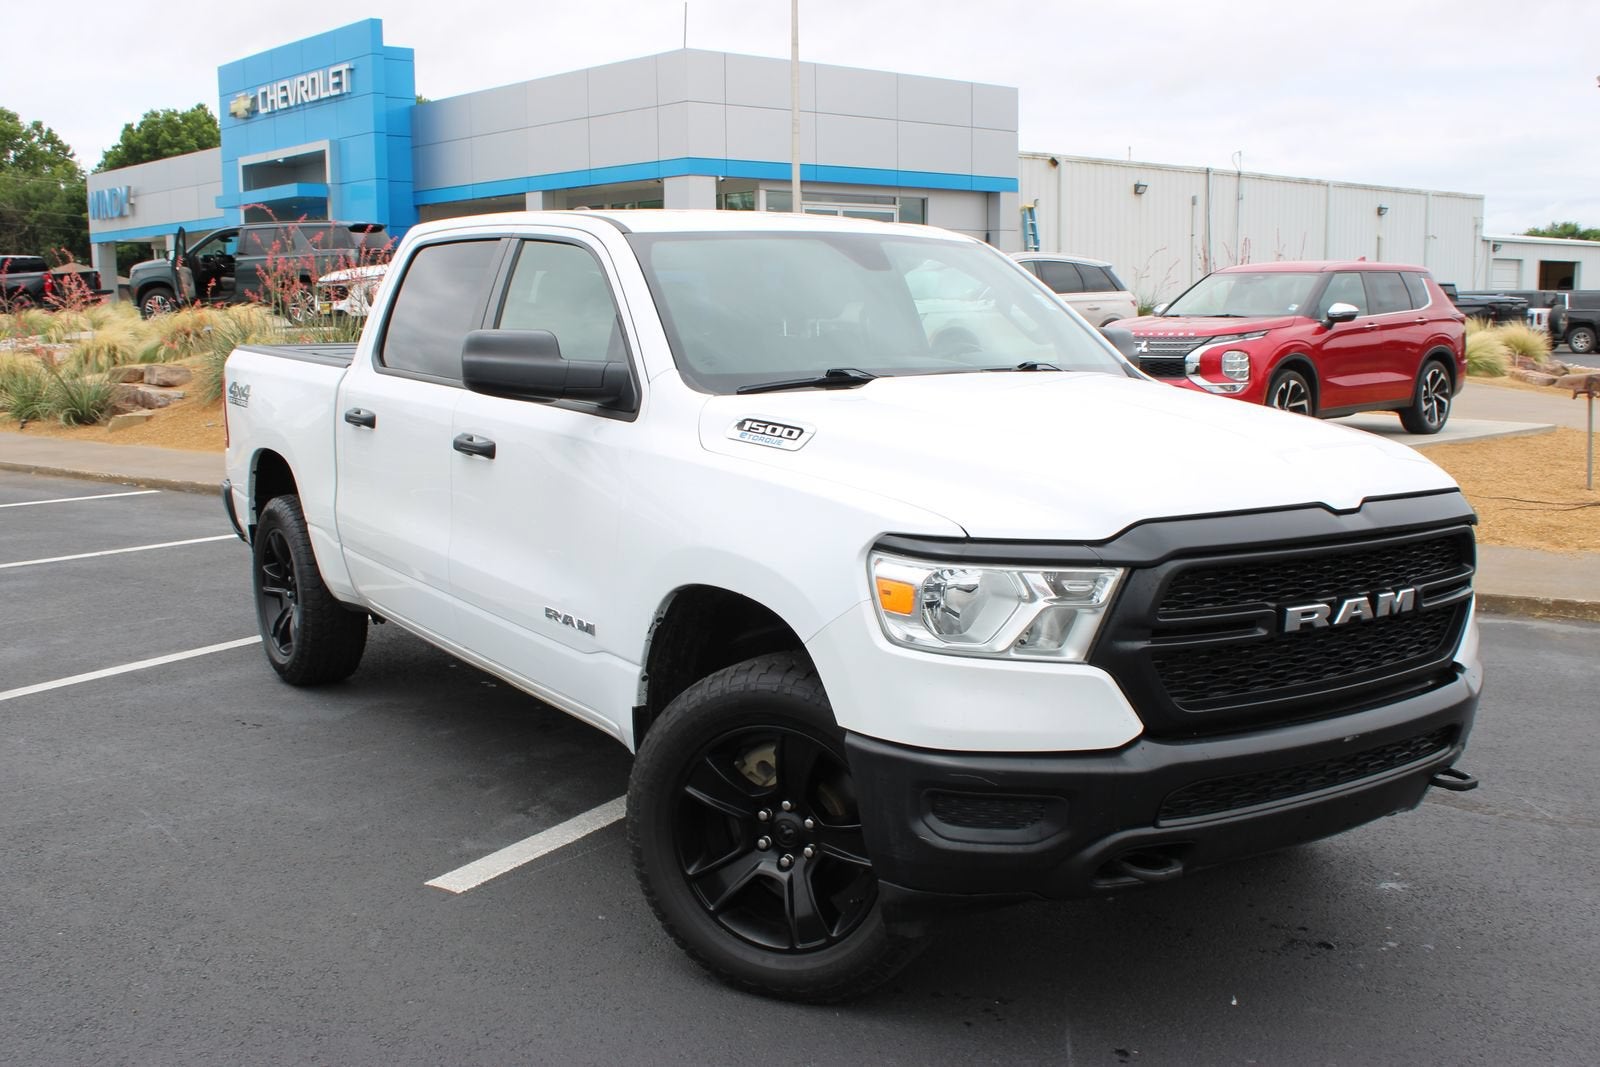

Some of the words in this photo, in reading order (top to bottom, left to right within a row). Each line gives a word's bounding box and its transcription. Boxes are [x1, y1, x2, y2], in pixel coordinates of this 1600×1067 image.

[257, 63, 353, 114] CHEVROLET
[88, 185, 132, 220] WINDY
[742, 419, 802, 440] 1500
[544, 606, 597, 637] RAM
[1283, 587, 1416, 633] RAM
